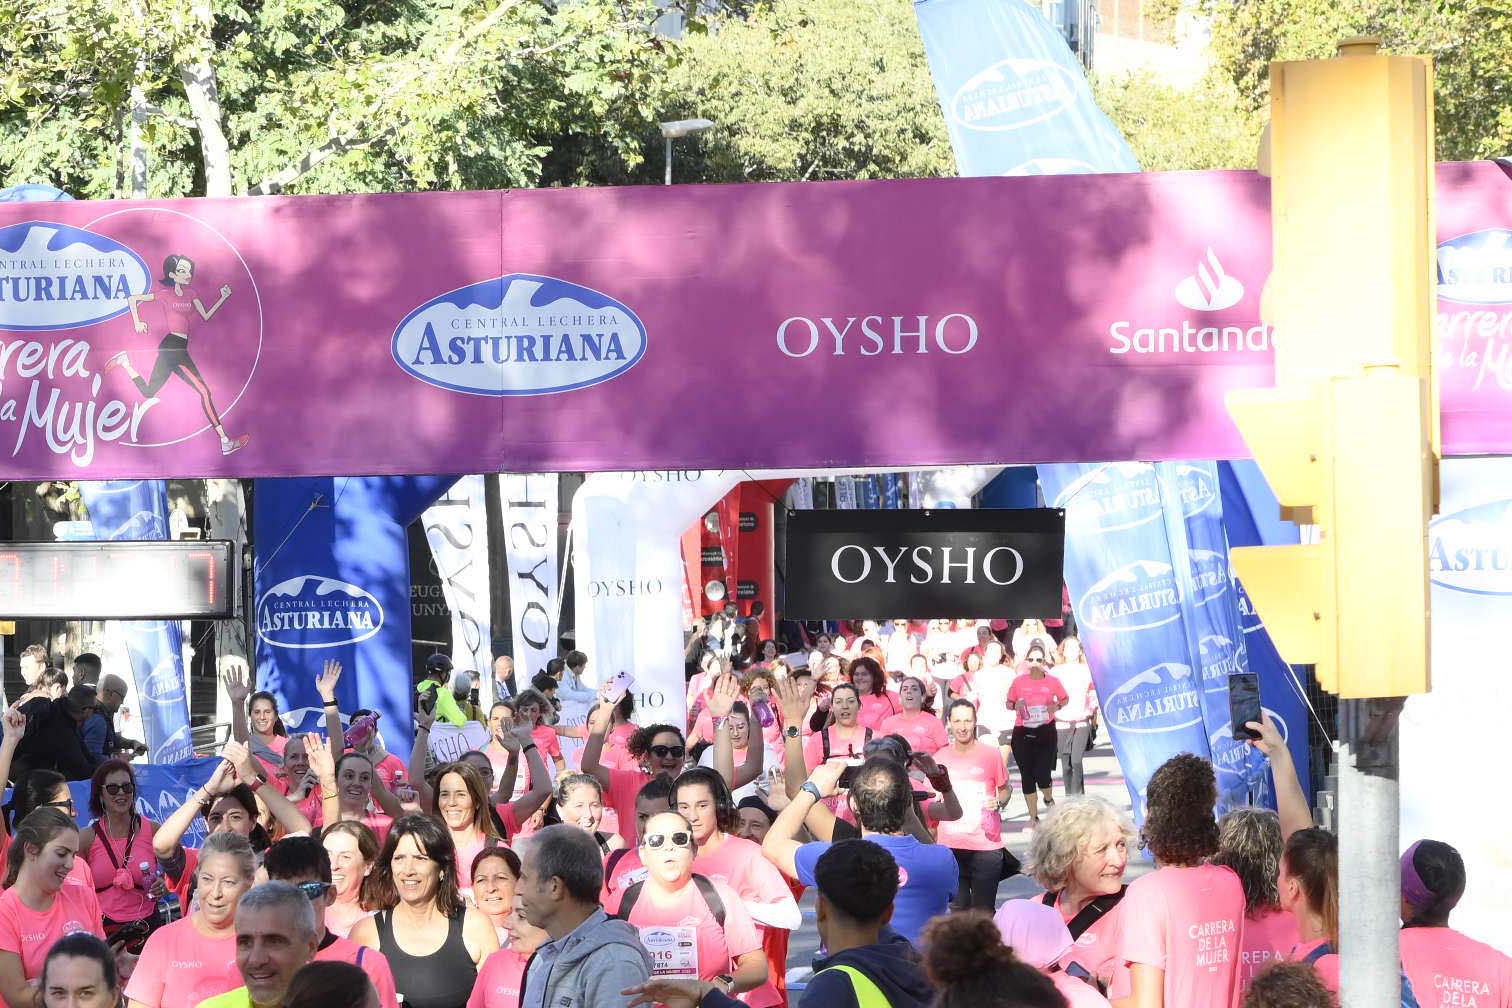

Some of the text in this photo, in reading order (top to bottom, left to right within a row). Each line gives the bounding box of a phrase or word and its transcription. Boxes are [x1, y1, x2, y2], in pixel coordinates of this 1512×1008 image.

[54, 257, 126, 270] LECHERA
[451, 315, 619, 330] CENTRAL LECHERA
[412, 322, 627, 365] ASTURIANA
[776, 313, 978, 358] OYSHO
[1110, 320, 1276, 354] Santand
[12, 374, 161, 467] Mujer
[831, 544, 1024, 586] OYSHO
[587, 579, 662, 598] OYSHO
[262, 603, 374, 632] ASTURIANA
[1188, 920, 1236, 941] CARRERA
[1198, 936, 1226, 950] DE LA
[1196, 949, 1229, 967] MUJER
[1433, 975, 1491, 995] CARRERA
[1443, 991, 1478, 1008] DE LA
